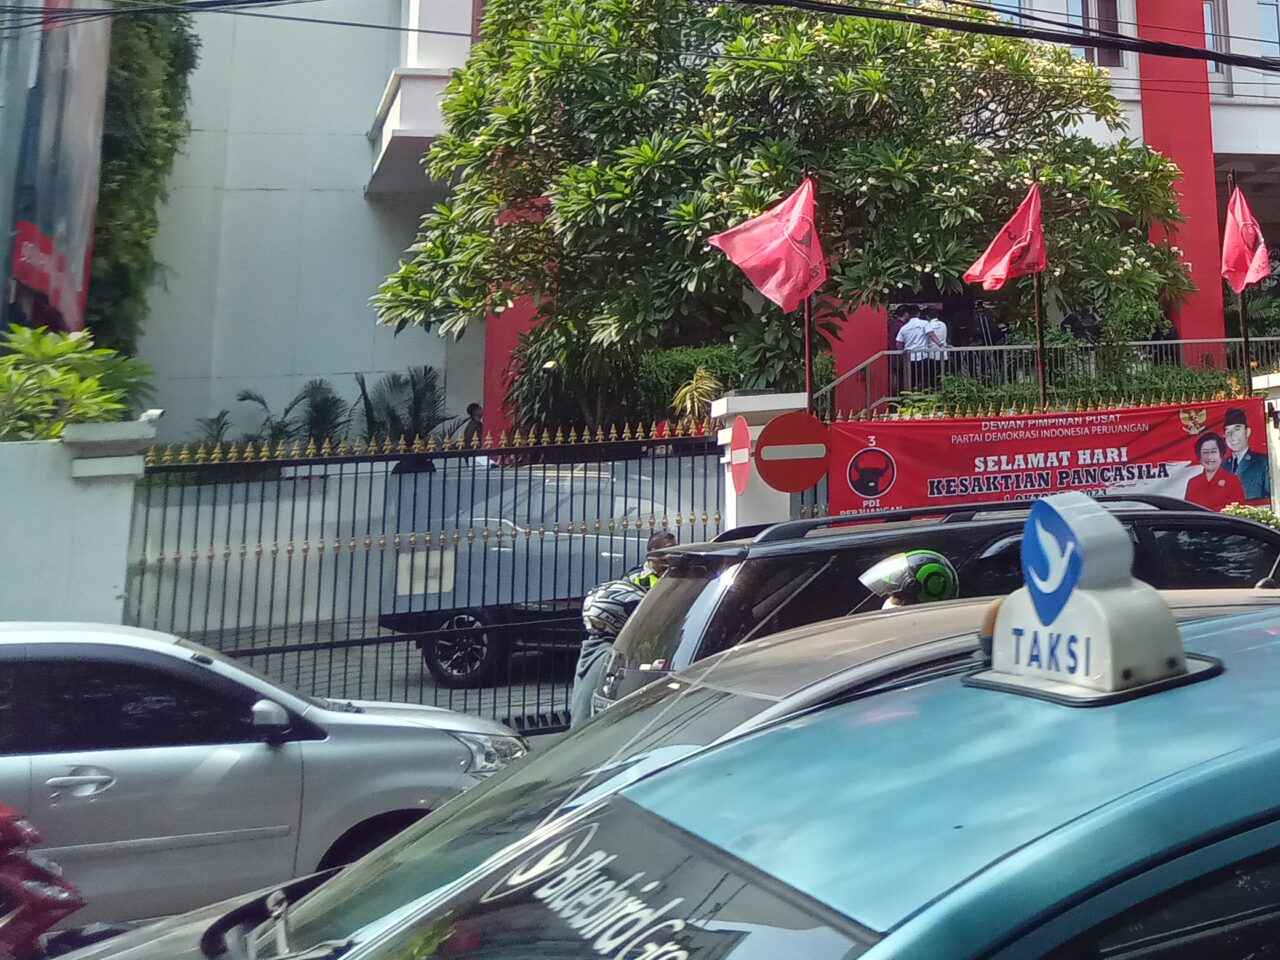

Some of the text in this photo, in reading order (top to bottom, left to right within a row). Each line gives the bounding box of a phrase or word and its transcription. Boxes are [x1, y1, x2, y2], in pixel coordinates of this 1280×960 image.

[981, 414, 1121, 431] DEWAN PIMPINAN PUSAT
[867, 435, 876, 447] 3
[951, 423, 1149, 444] PARTAI DEMOKRASI INDONESIA PERJUANGAN
[974, 446, 1128, 473] SELAMAT HARI
[927, 462, 1170, 498] KESAKTIAN PANCASILA
[862, 499, 881, 508] PDI
[1011, 627, 1091, 676] TAKSI
